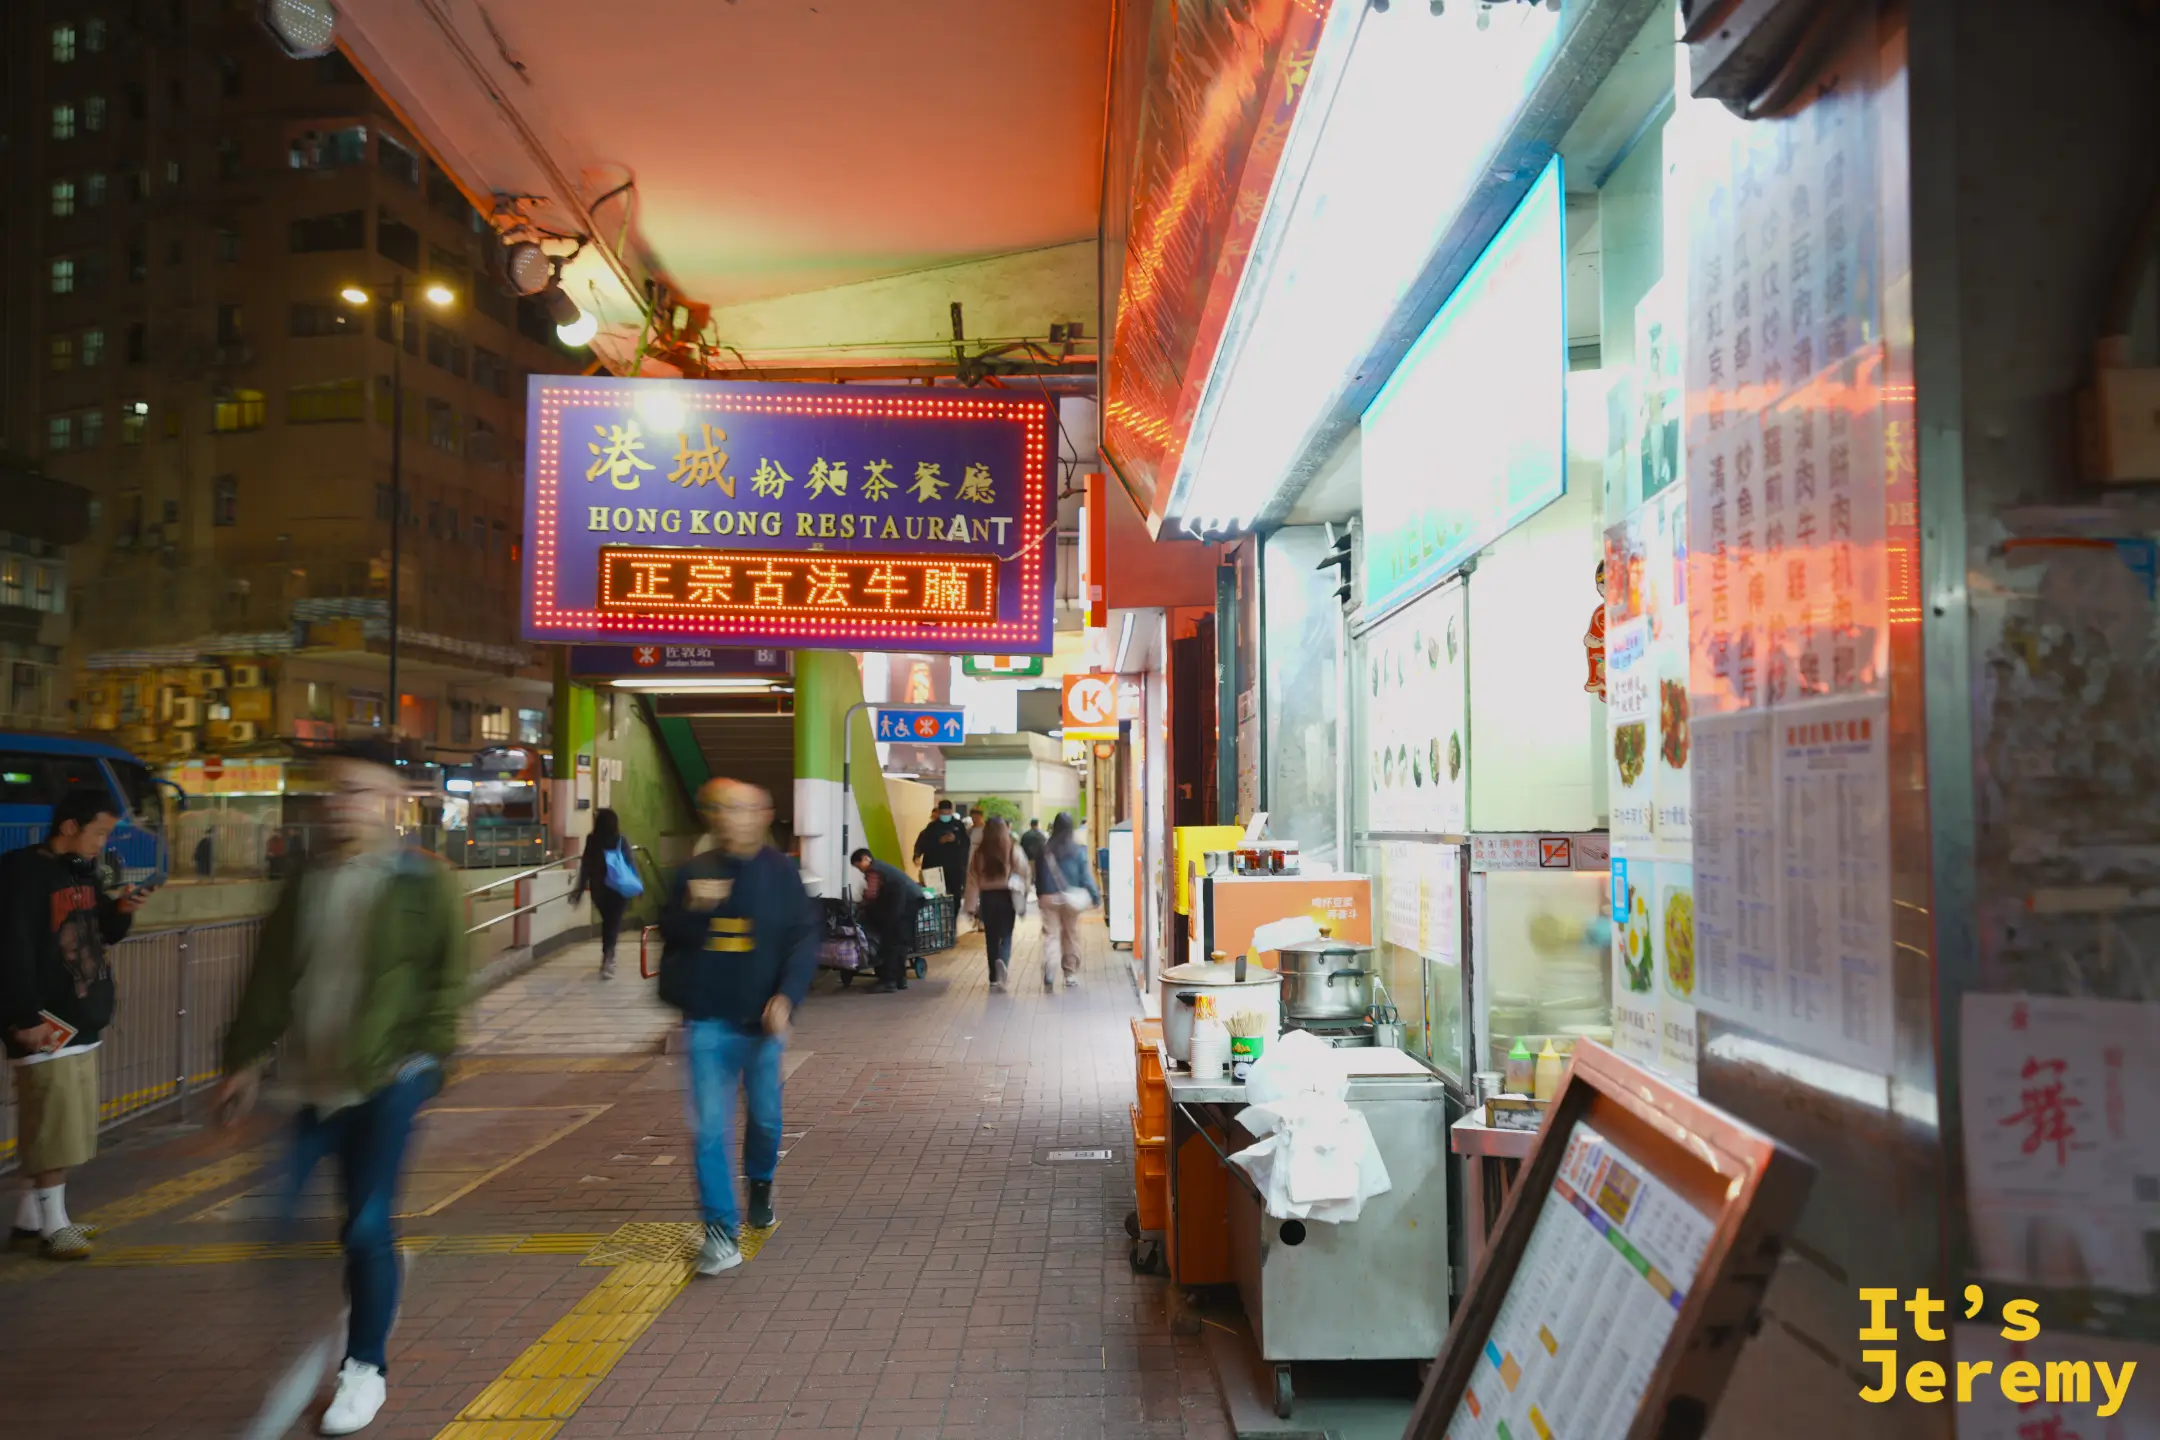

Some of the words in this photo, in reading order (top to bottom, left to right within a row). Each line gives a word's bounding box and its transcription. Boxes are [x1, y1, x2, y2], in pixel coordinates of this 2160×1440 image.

[588, 506, 682, 533] HONG
[689, 510, 783, 537] KONG
[796, 513, 1013, 545] RESTAURANT
[627, 562, 969, 611] 正宗古法牛腩
